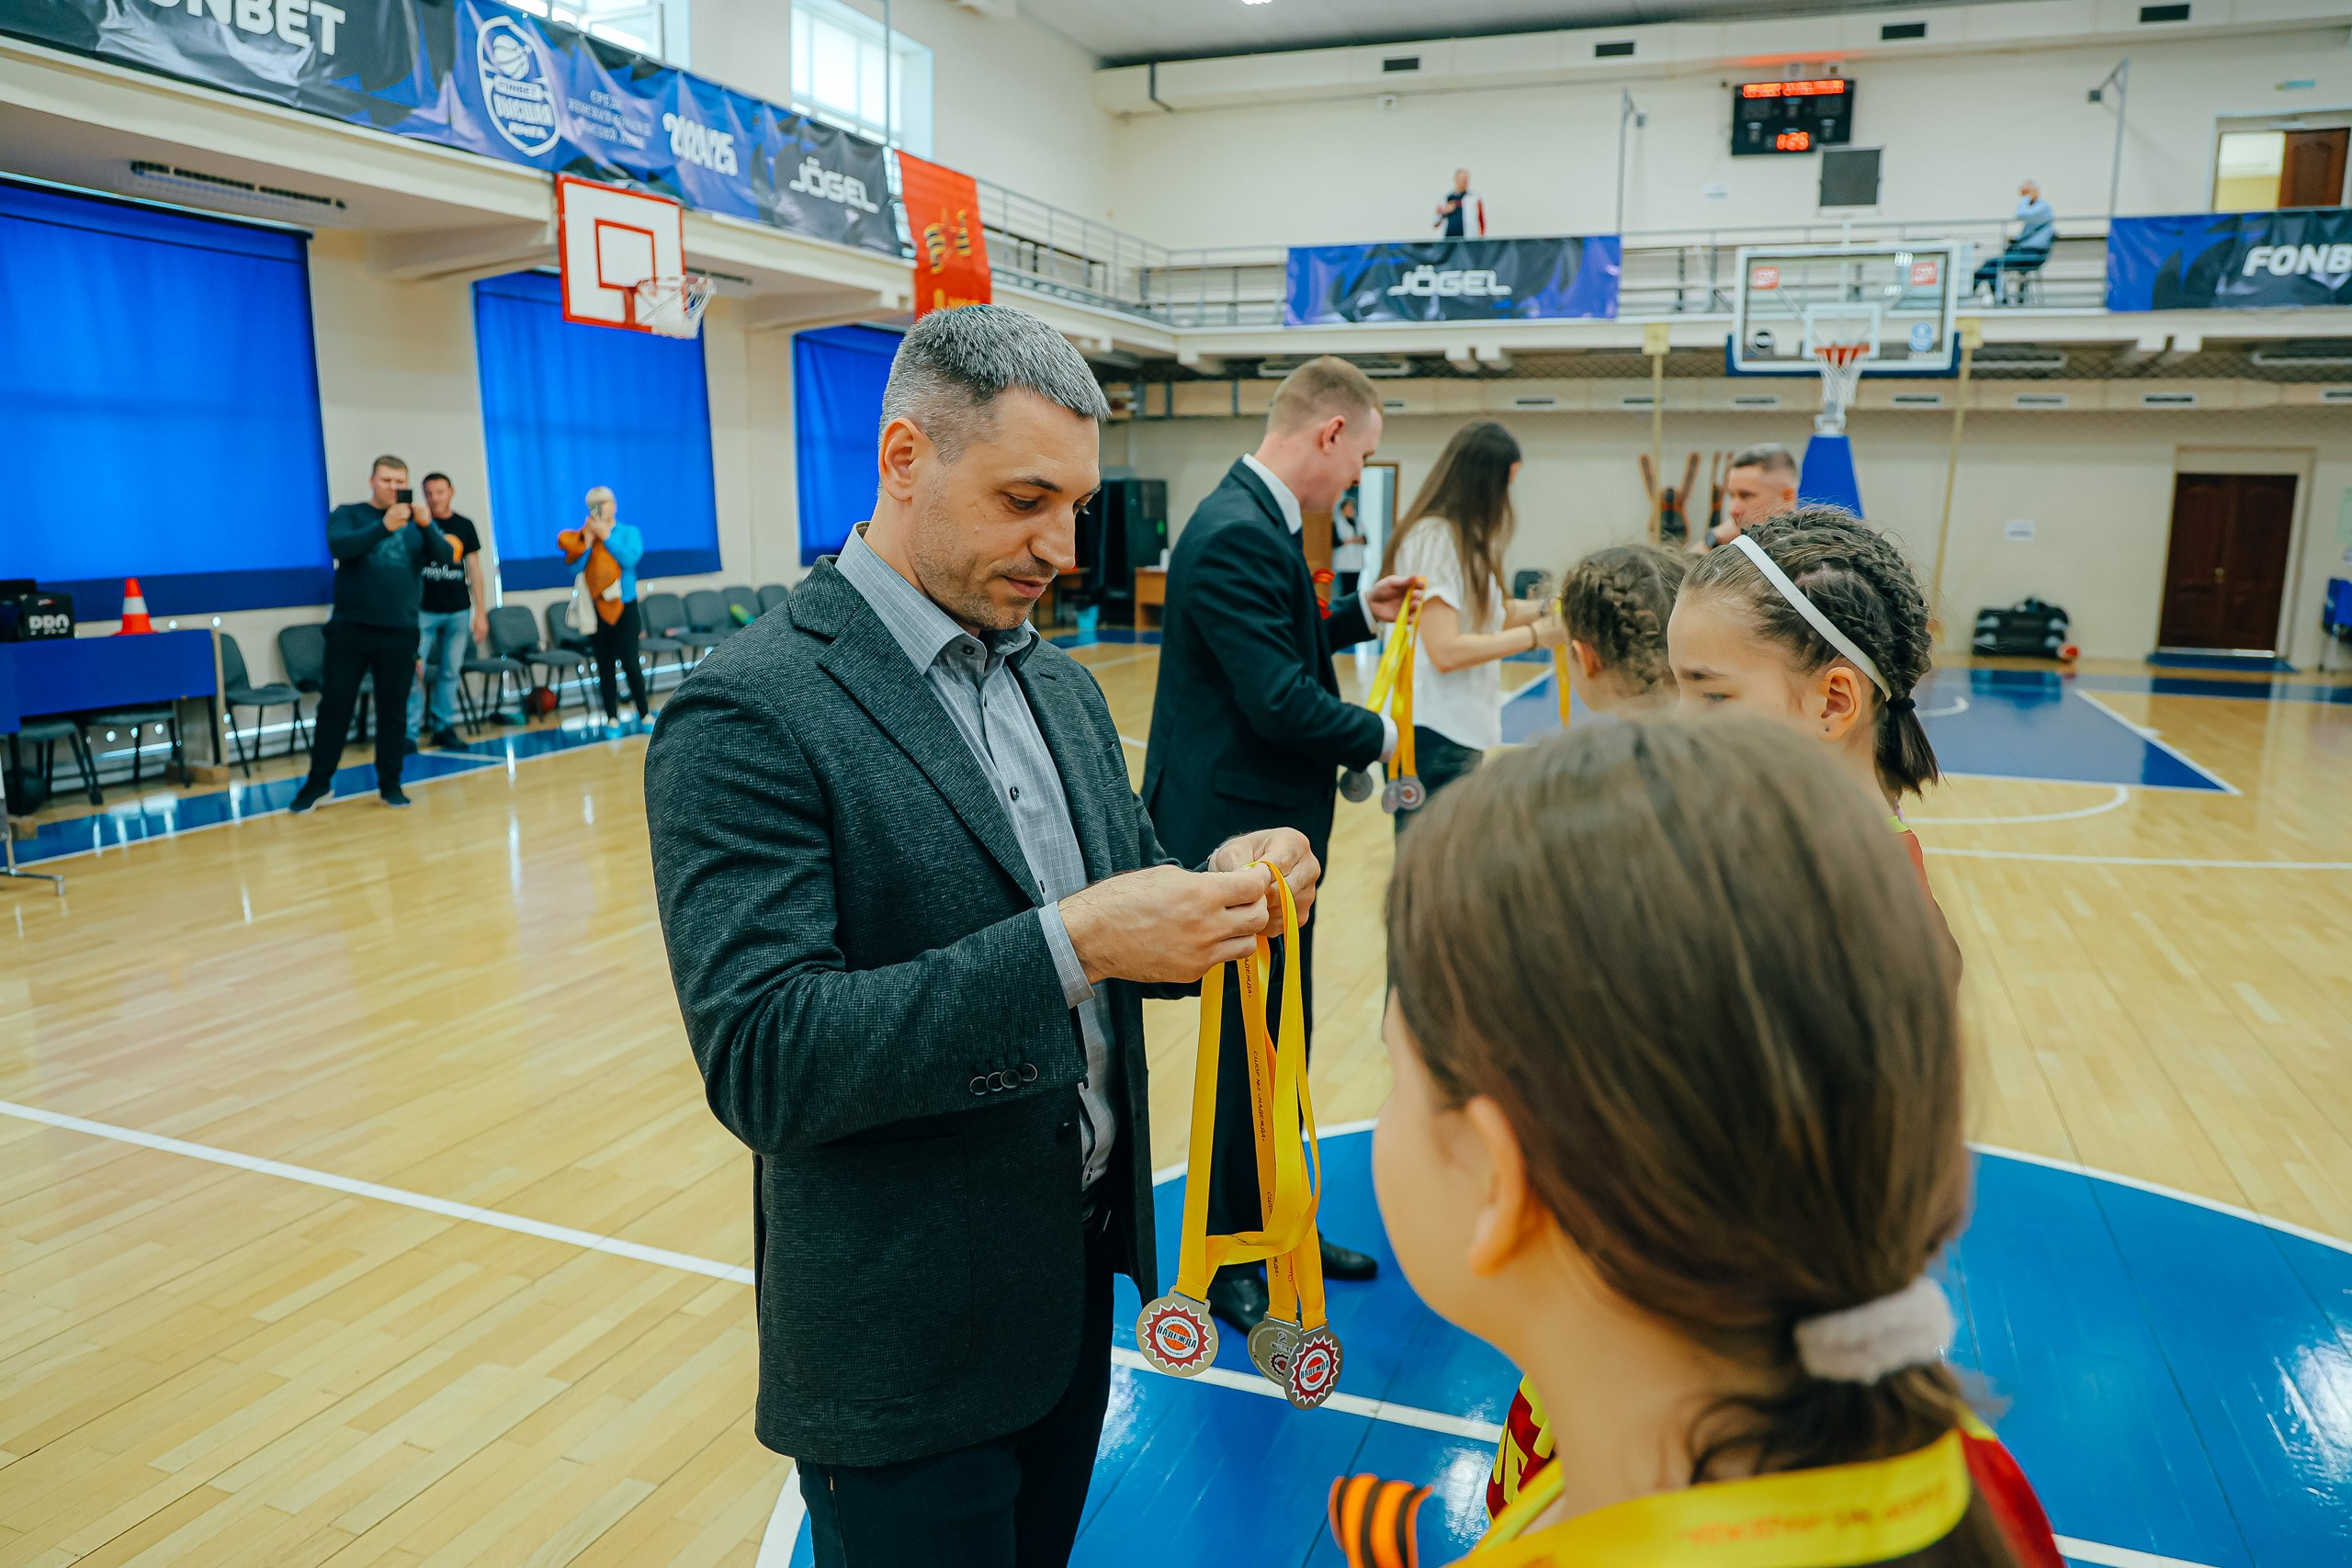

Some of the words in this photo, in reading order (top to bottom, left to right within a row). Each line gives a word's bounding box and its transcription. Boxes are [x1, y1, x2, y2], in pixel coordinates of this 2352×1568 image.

[152, 0, 346, 56] BET
[788, 155, 880, 214] JÖGEL
[1387, 264, 1512, 297] JÖGEL
[28, 613, 70, 631] PRO
[1157, 1325, 1197, 1349] НАДЕЖДА
[1278, 1332, 1288, 1344] 2
